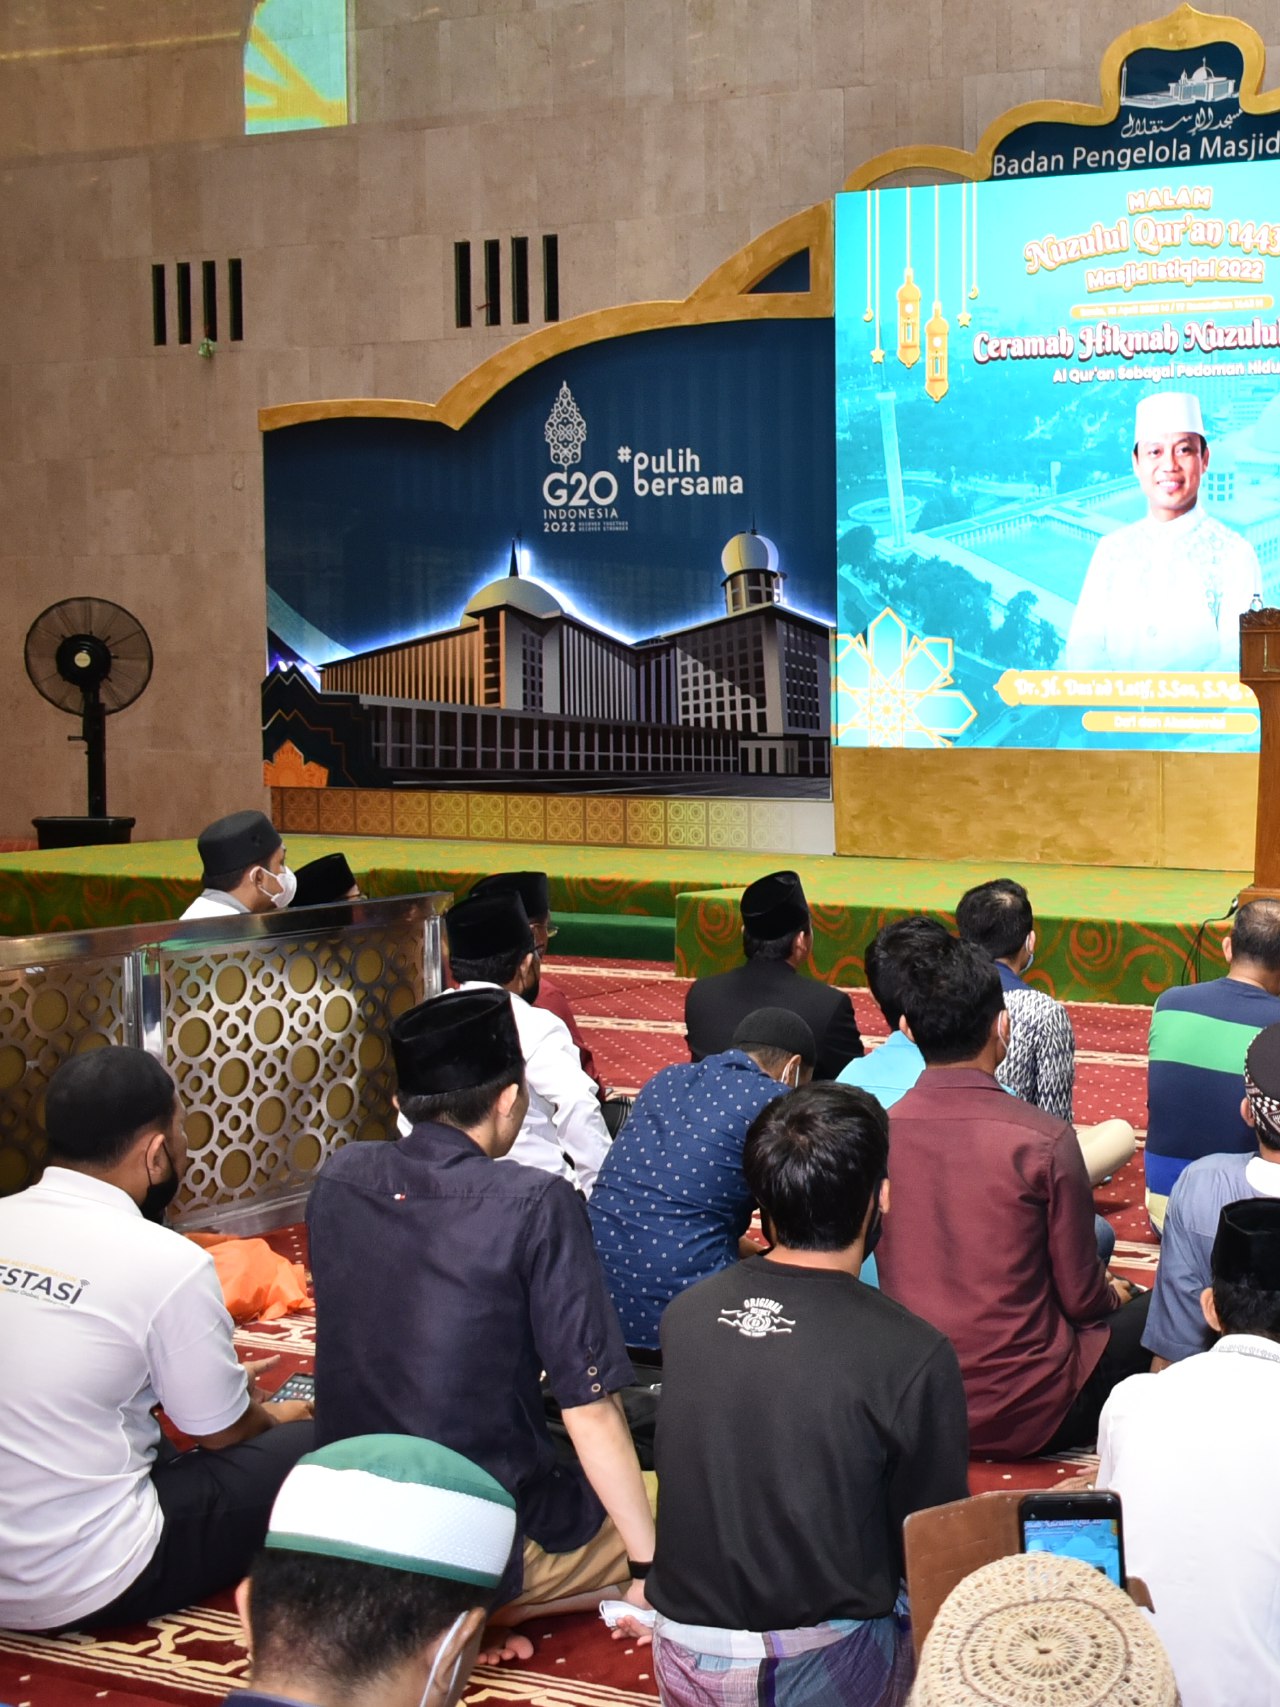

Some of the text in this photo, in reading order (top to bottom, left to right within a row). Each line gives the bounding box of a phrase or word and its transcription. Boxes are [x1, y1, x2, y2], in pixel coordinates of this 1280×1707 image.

[993, 150, 1064, 176] Badan
[1072, 138, 1191, 171] Pengelola
[1200, 130, 1280, 162] Masjid
[1128, 188, 1211, 214] MALAM
[1025, 219, 1129, 273] Nuzulul
[1134, 214, 1224, 255] Qur'an
[1087, 258, 1264, 292] Masjid Istiqlal 2022
[973, 327, 1074, 364] Ceramah
[1078, 320, 1179, 362] Hikmah
[1053, 368, 1067, 383] Al
[1069, 366, 1115, 384] Qur'an
[1117, 363, 1175, 383] Sebagai
[1177, 361, 1245, 378] Pedoman
[617, 446, 700, 475] #pulih
[542, 470, 619, 507] G20
[634, 475, 744, 497] bersama
[543, 508, 618, 520] INDONESIA
[544, 522, 576, 533] 2022
[743, 1297, 784, 1315] ORIGINAL
